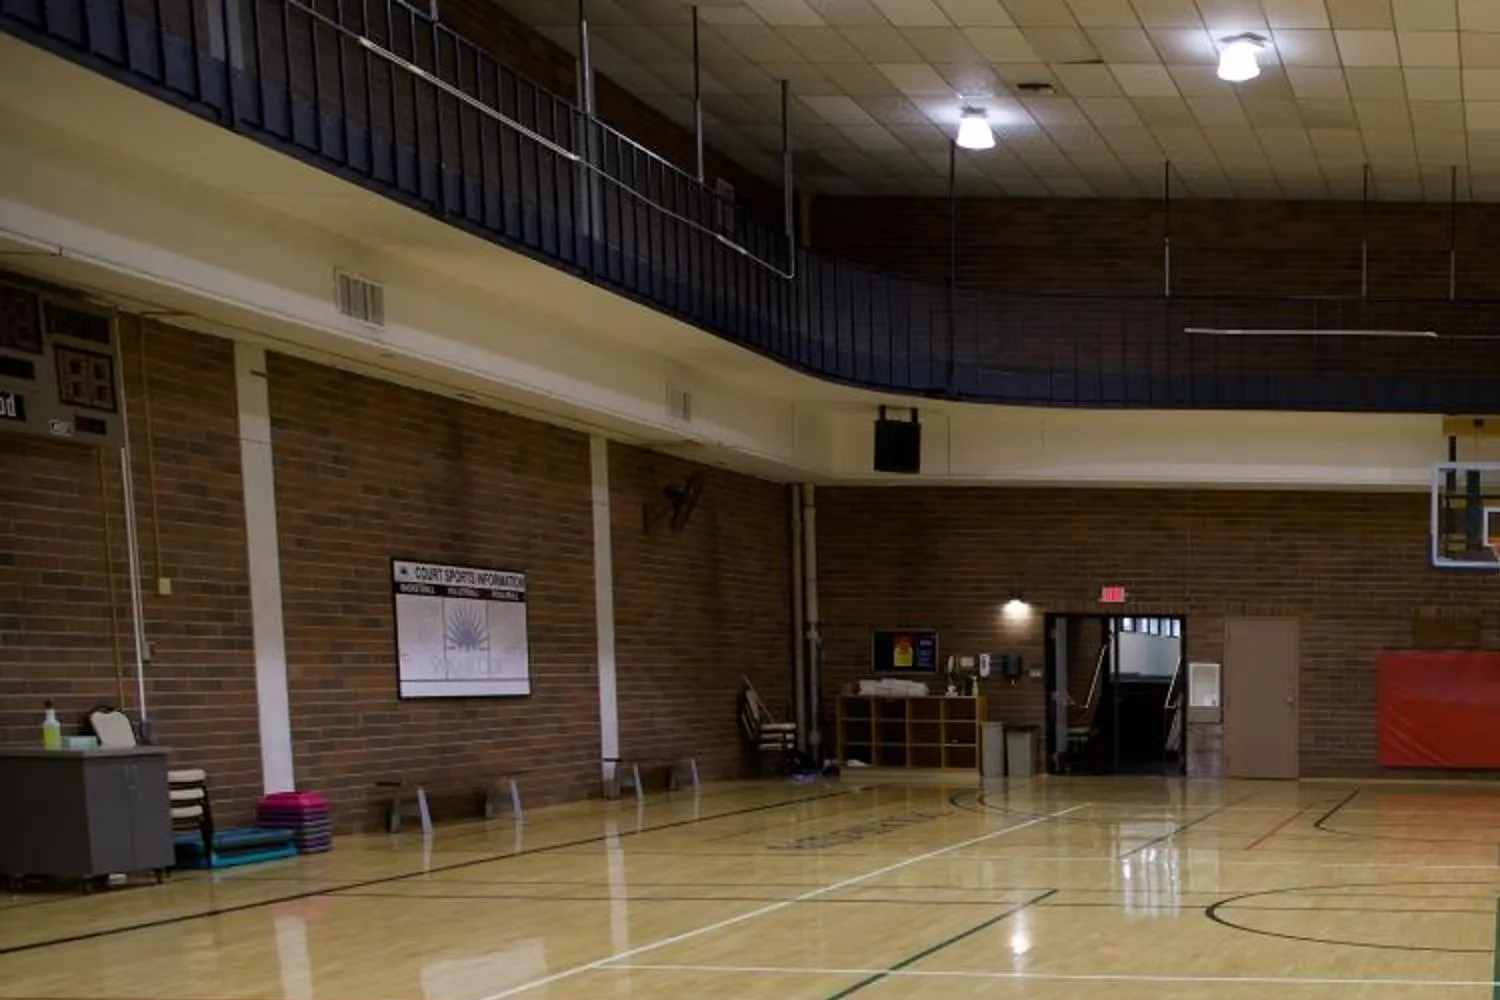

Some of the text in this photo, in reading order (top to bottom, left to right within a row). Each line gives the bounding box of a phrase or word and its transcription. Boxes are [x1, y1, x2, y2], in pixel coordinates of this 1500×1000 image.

[415, 566, 525, 588] COURT SPORTS INFORMATION
